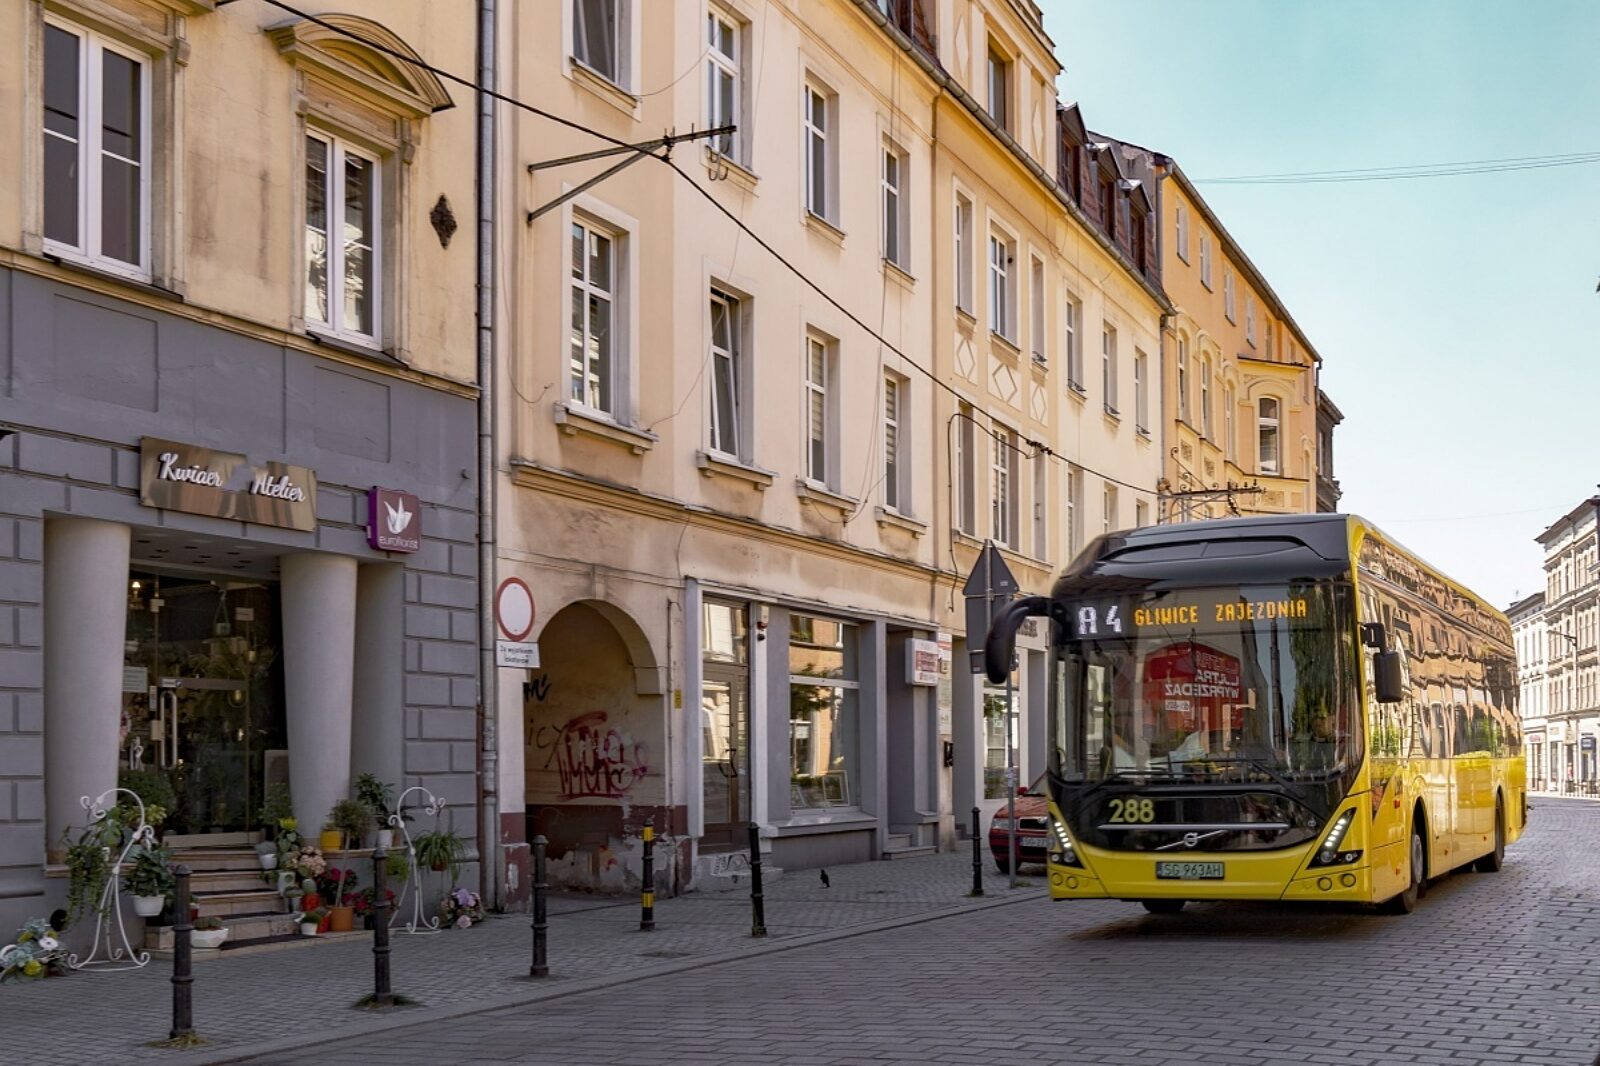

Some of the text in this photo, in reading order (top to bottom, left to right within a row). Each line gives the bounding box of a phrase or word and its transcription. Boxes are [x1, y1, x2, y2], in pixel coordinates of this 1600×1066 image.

[1134, 605, 1198, 626] GLIWICE
[1215, 599, 1307, 622] ZAJEZDNIA
[1108, 798, 1155, 823] 288
